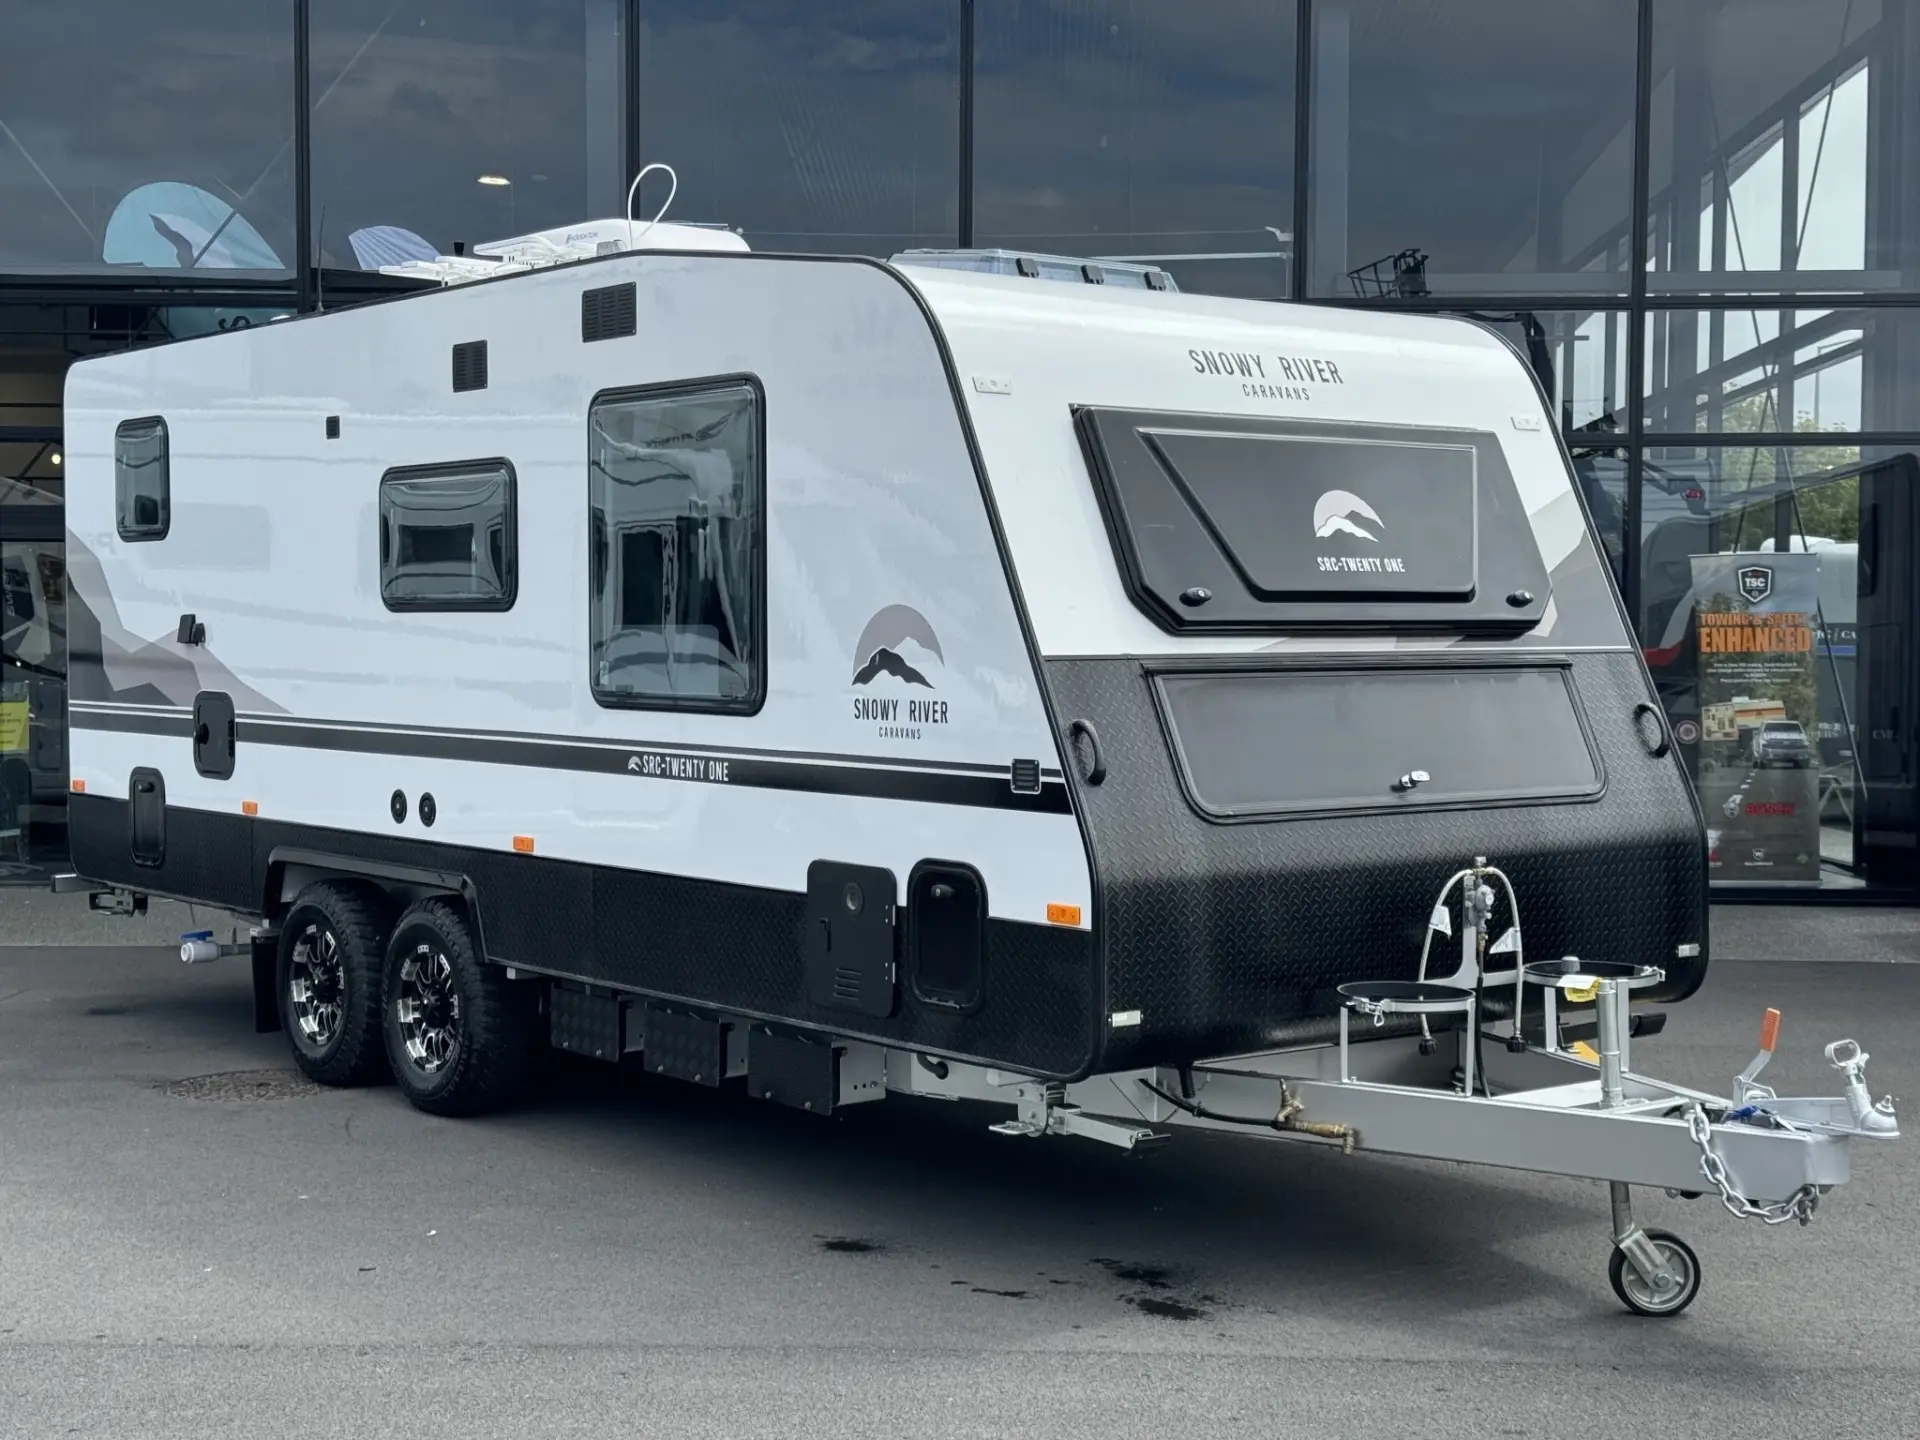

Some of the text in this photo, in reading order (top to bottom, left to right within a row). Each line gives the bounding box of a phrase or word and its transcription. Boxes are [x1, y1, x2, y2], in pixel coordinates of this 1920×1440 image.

[1188, 349, 1344, 384] SNOWY RIVER
[1242, 383, 1310, 401] CARAVANS
[1316, 556, 1406, 572] SRC-TWENTY ONE
[1744, 577, 1766, 588] TSC
[1700, 613, 1749, 626] TOWING
[1700, 627, 1812, 653] ENHANCED
[853, 697, 948, 724] SNOWY RIVER
[878, 726, 921, 740] CARAVANS
[642, 755, 729, 781] SRC-TWENTY ONE
